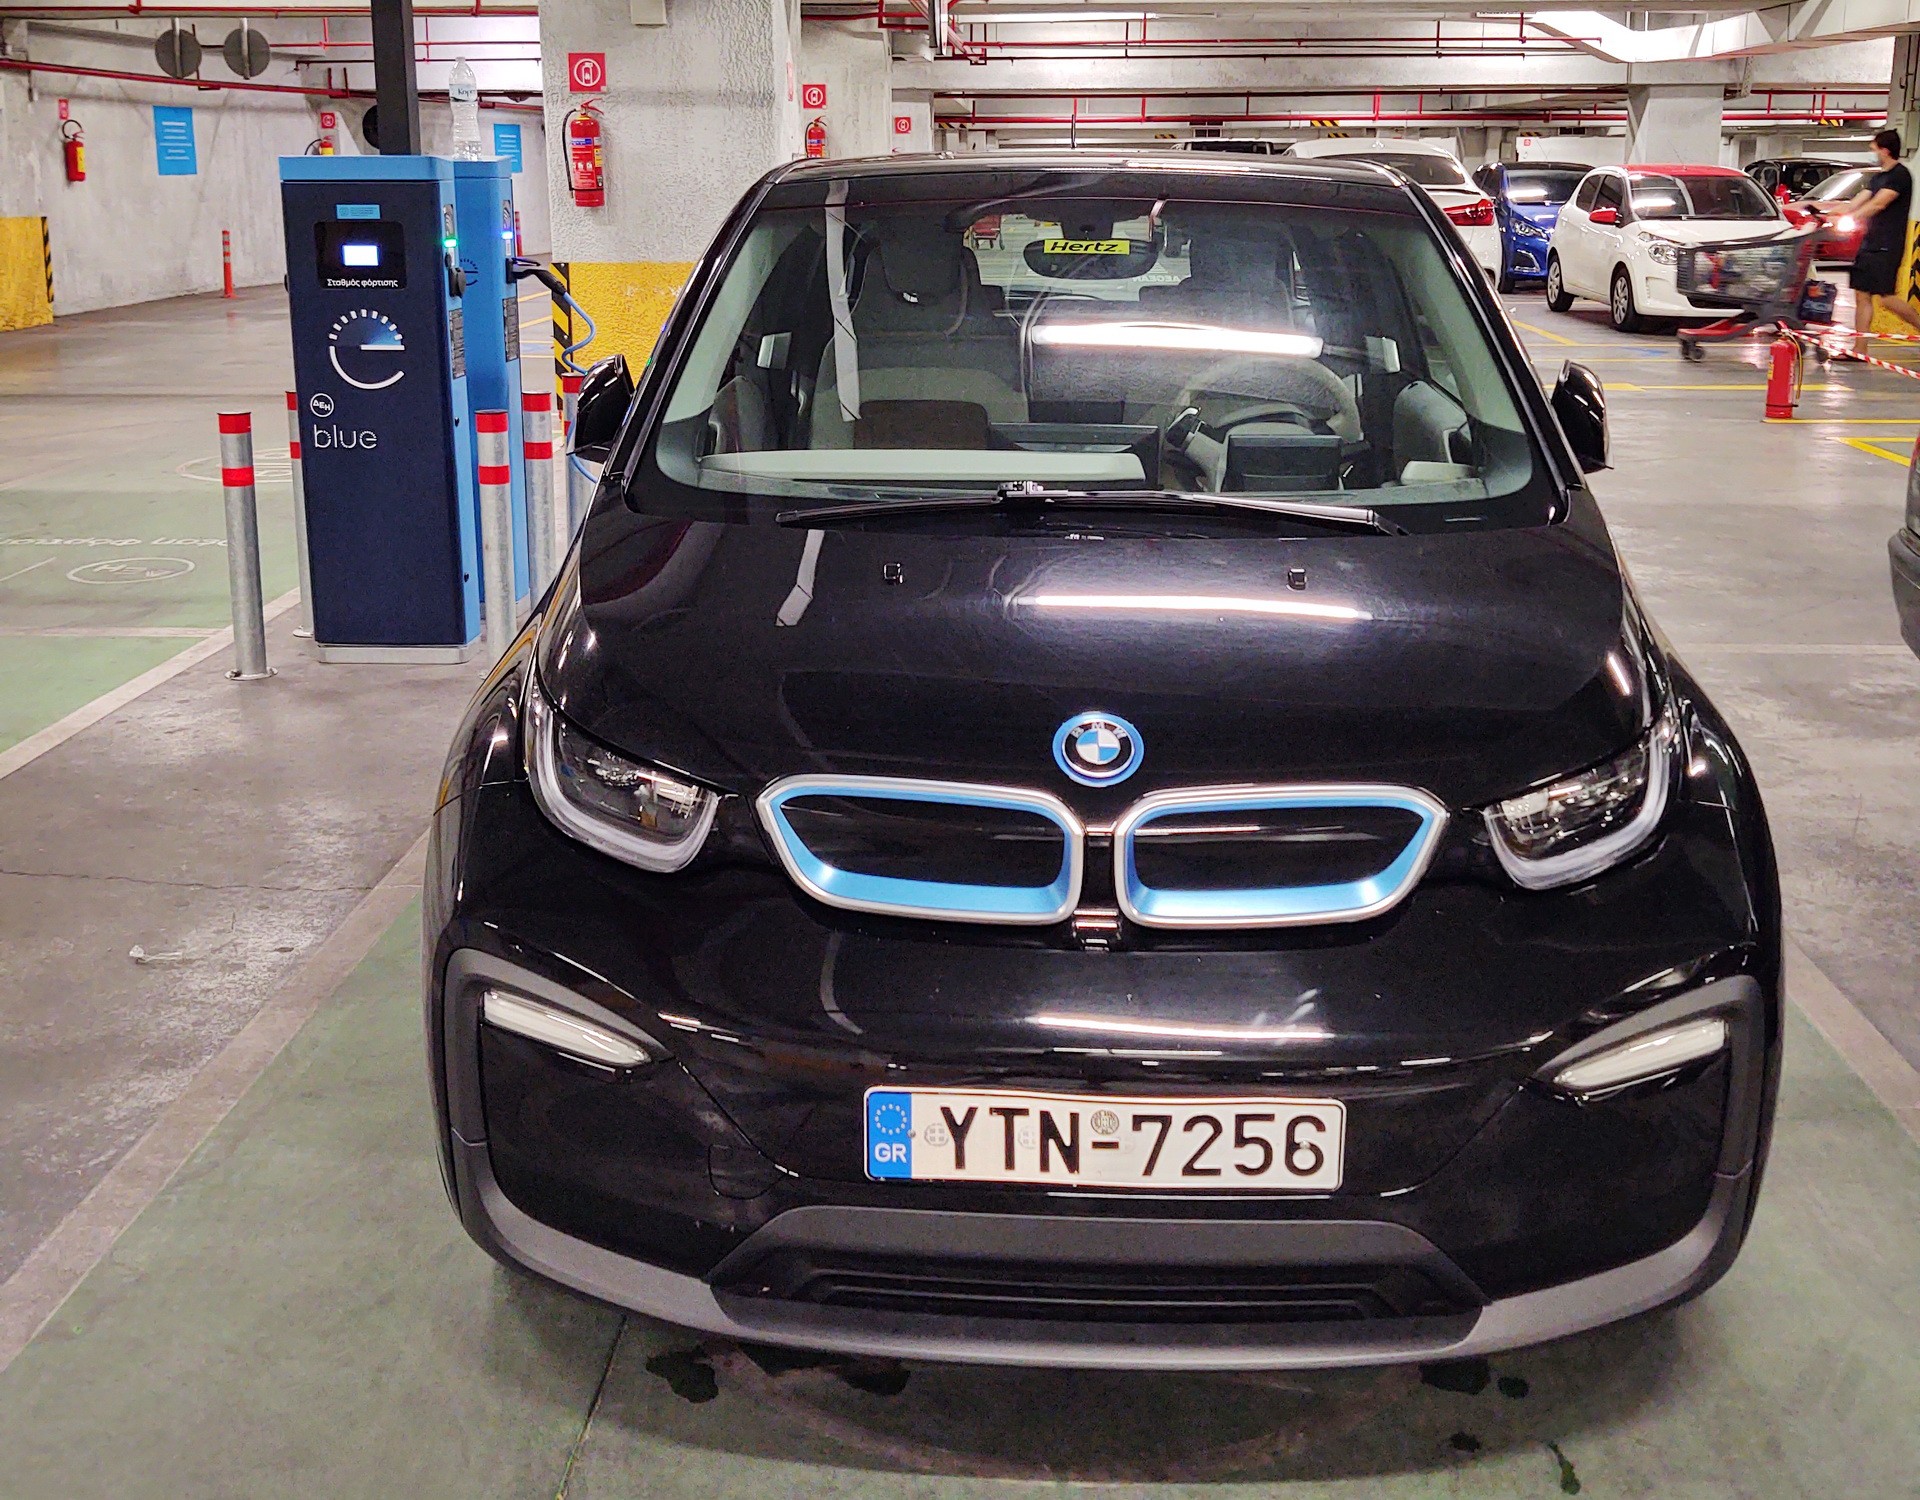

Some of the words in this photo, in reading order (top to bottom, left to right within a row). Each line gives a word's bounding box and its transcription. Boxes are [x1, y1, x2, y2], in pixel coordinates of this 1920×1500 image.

[1050, 241, 1119, 252] Hertz
[327, 278, 360, 288] Σταθμός
[361, 278, 398, 288] φόρτισης
[313, 424, 377, 449] blue
[1070, 721, 1128, 740] BMW
[940, 1105, 1326, 1178] YTN-7256
[874, 1142, 907, 1164] GR
